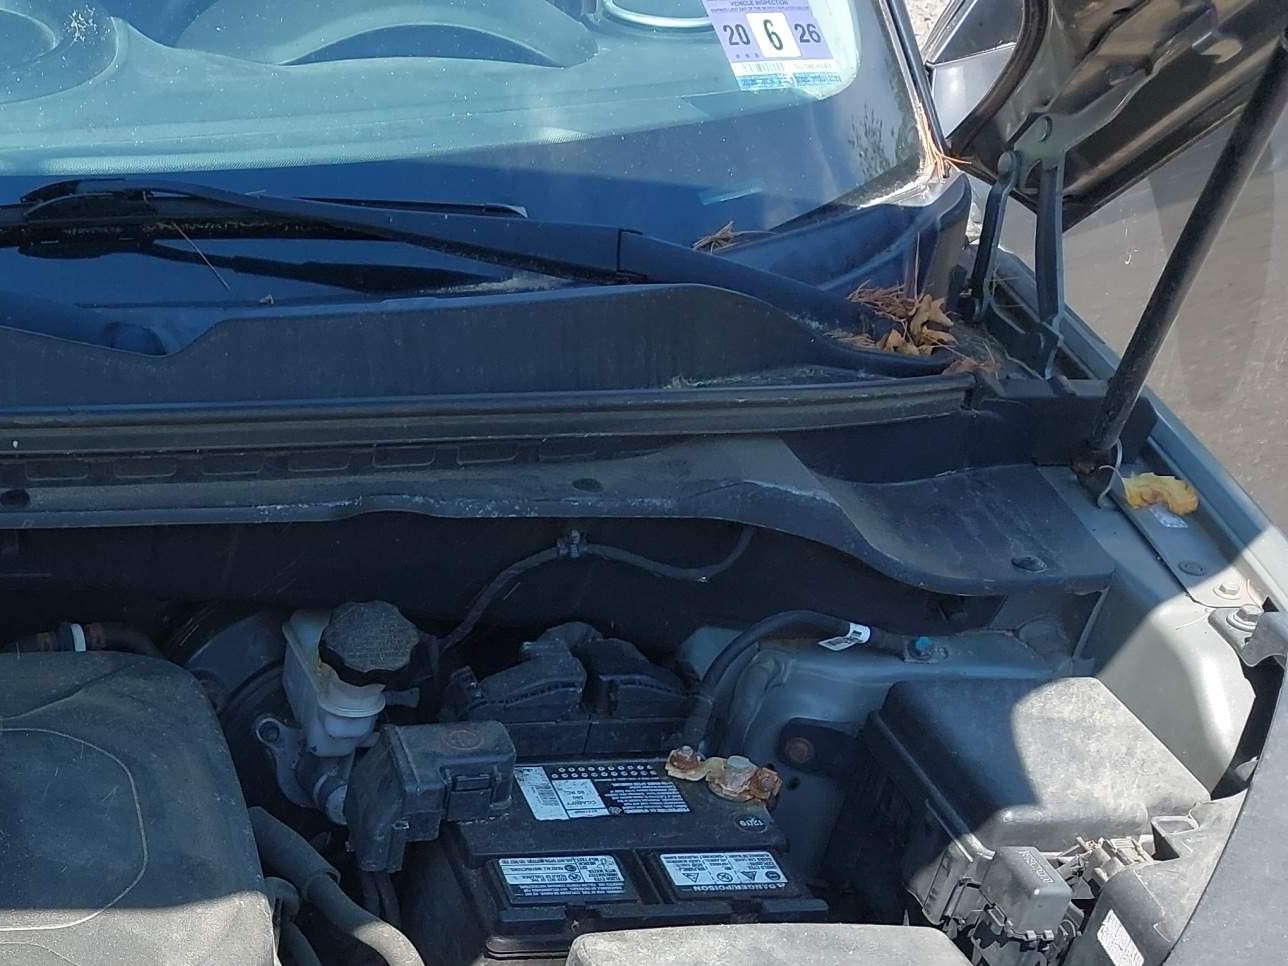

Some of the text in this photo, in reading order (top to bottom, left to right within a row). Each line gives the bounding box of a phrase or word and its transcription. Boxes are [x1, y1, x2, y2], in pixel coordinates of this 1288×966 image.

[723, 19, 822, 51] 20 6 26
